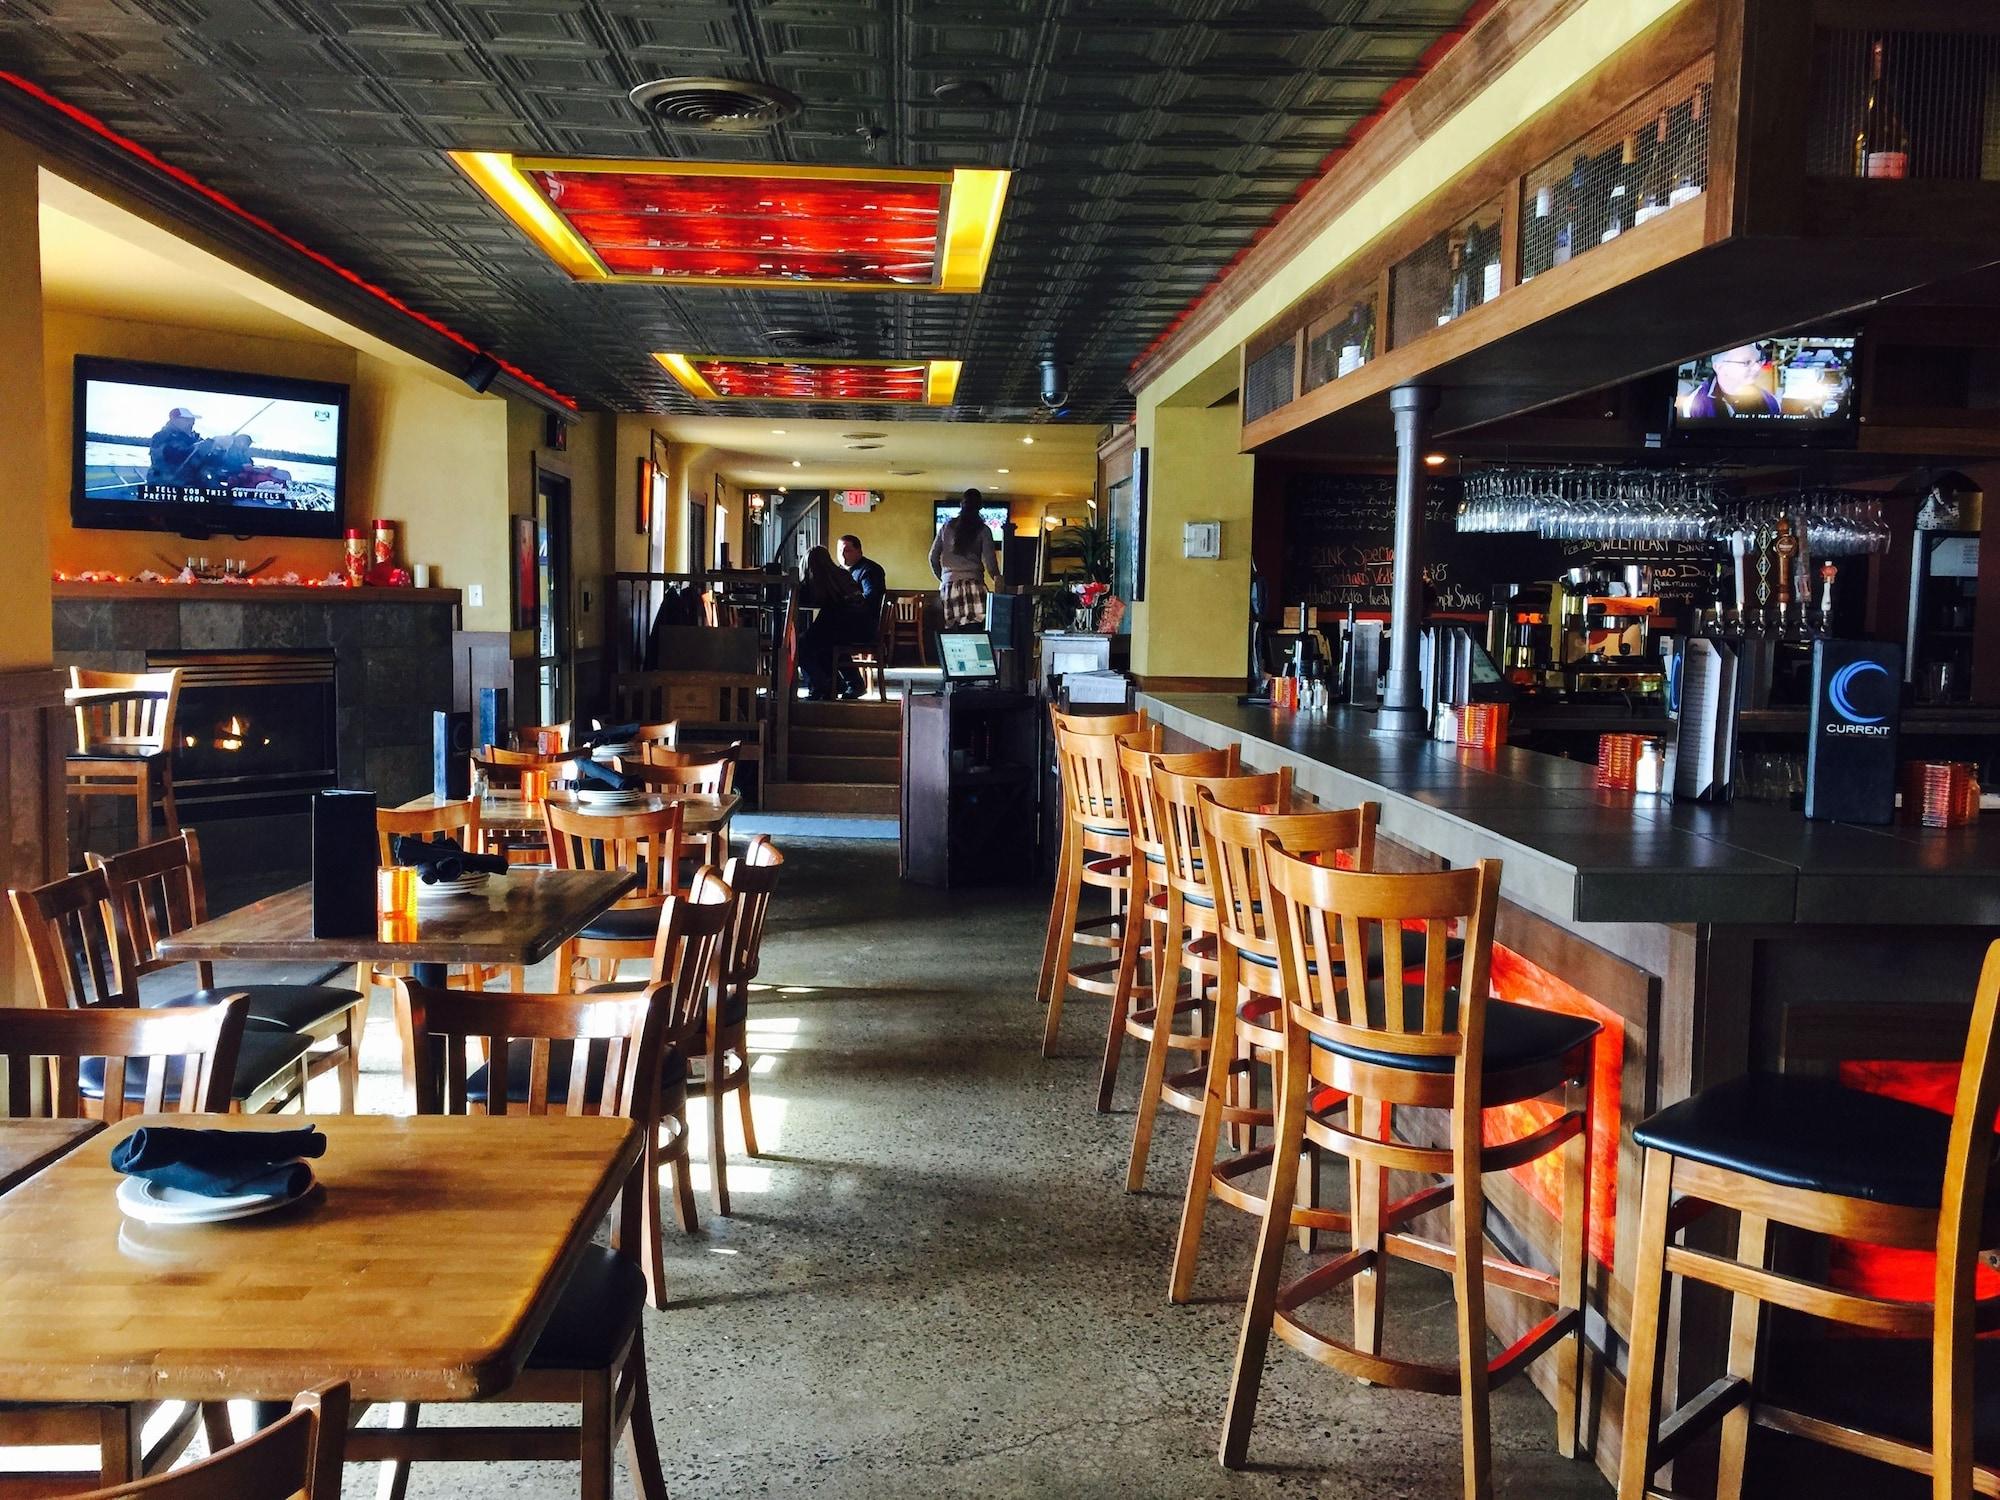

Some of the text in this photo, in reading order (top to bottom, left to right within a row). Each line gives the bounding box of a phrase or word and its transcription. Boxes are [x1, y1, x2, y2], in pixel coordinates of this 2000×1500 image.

[143, 493, 209, 503] PRETTY GOOD.
[155, 486, 177, 494] TELL
[183, 487, 200, 495] YOU
[206, 489, 227, 497] THIS
[254, 491, 280, 499] FEELS
[849, 493, 866, 506] EXIT
[1826, 723, 1891, 736] CURRENT
